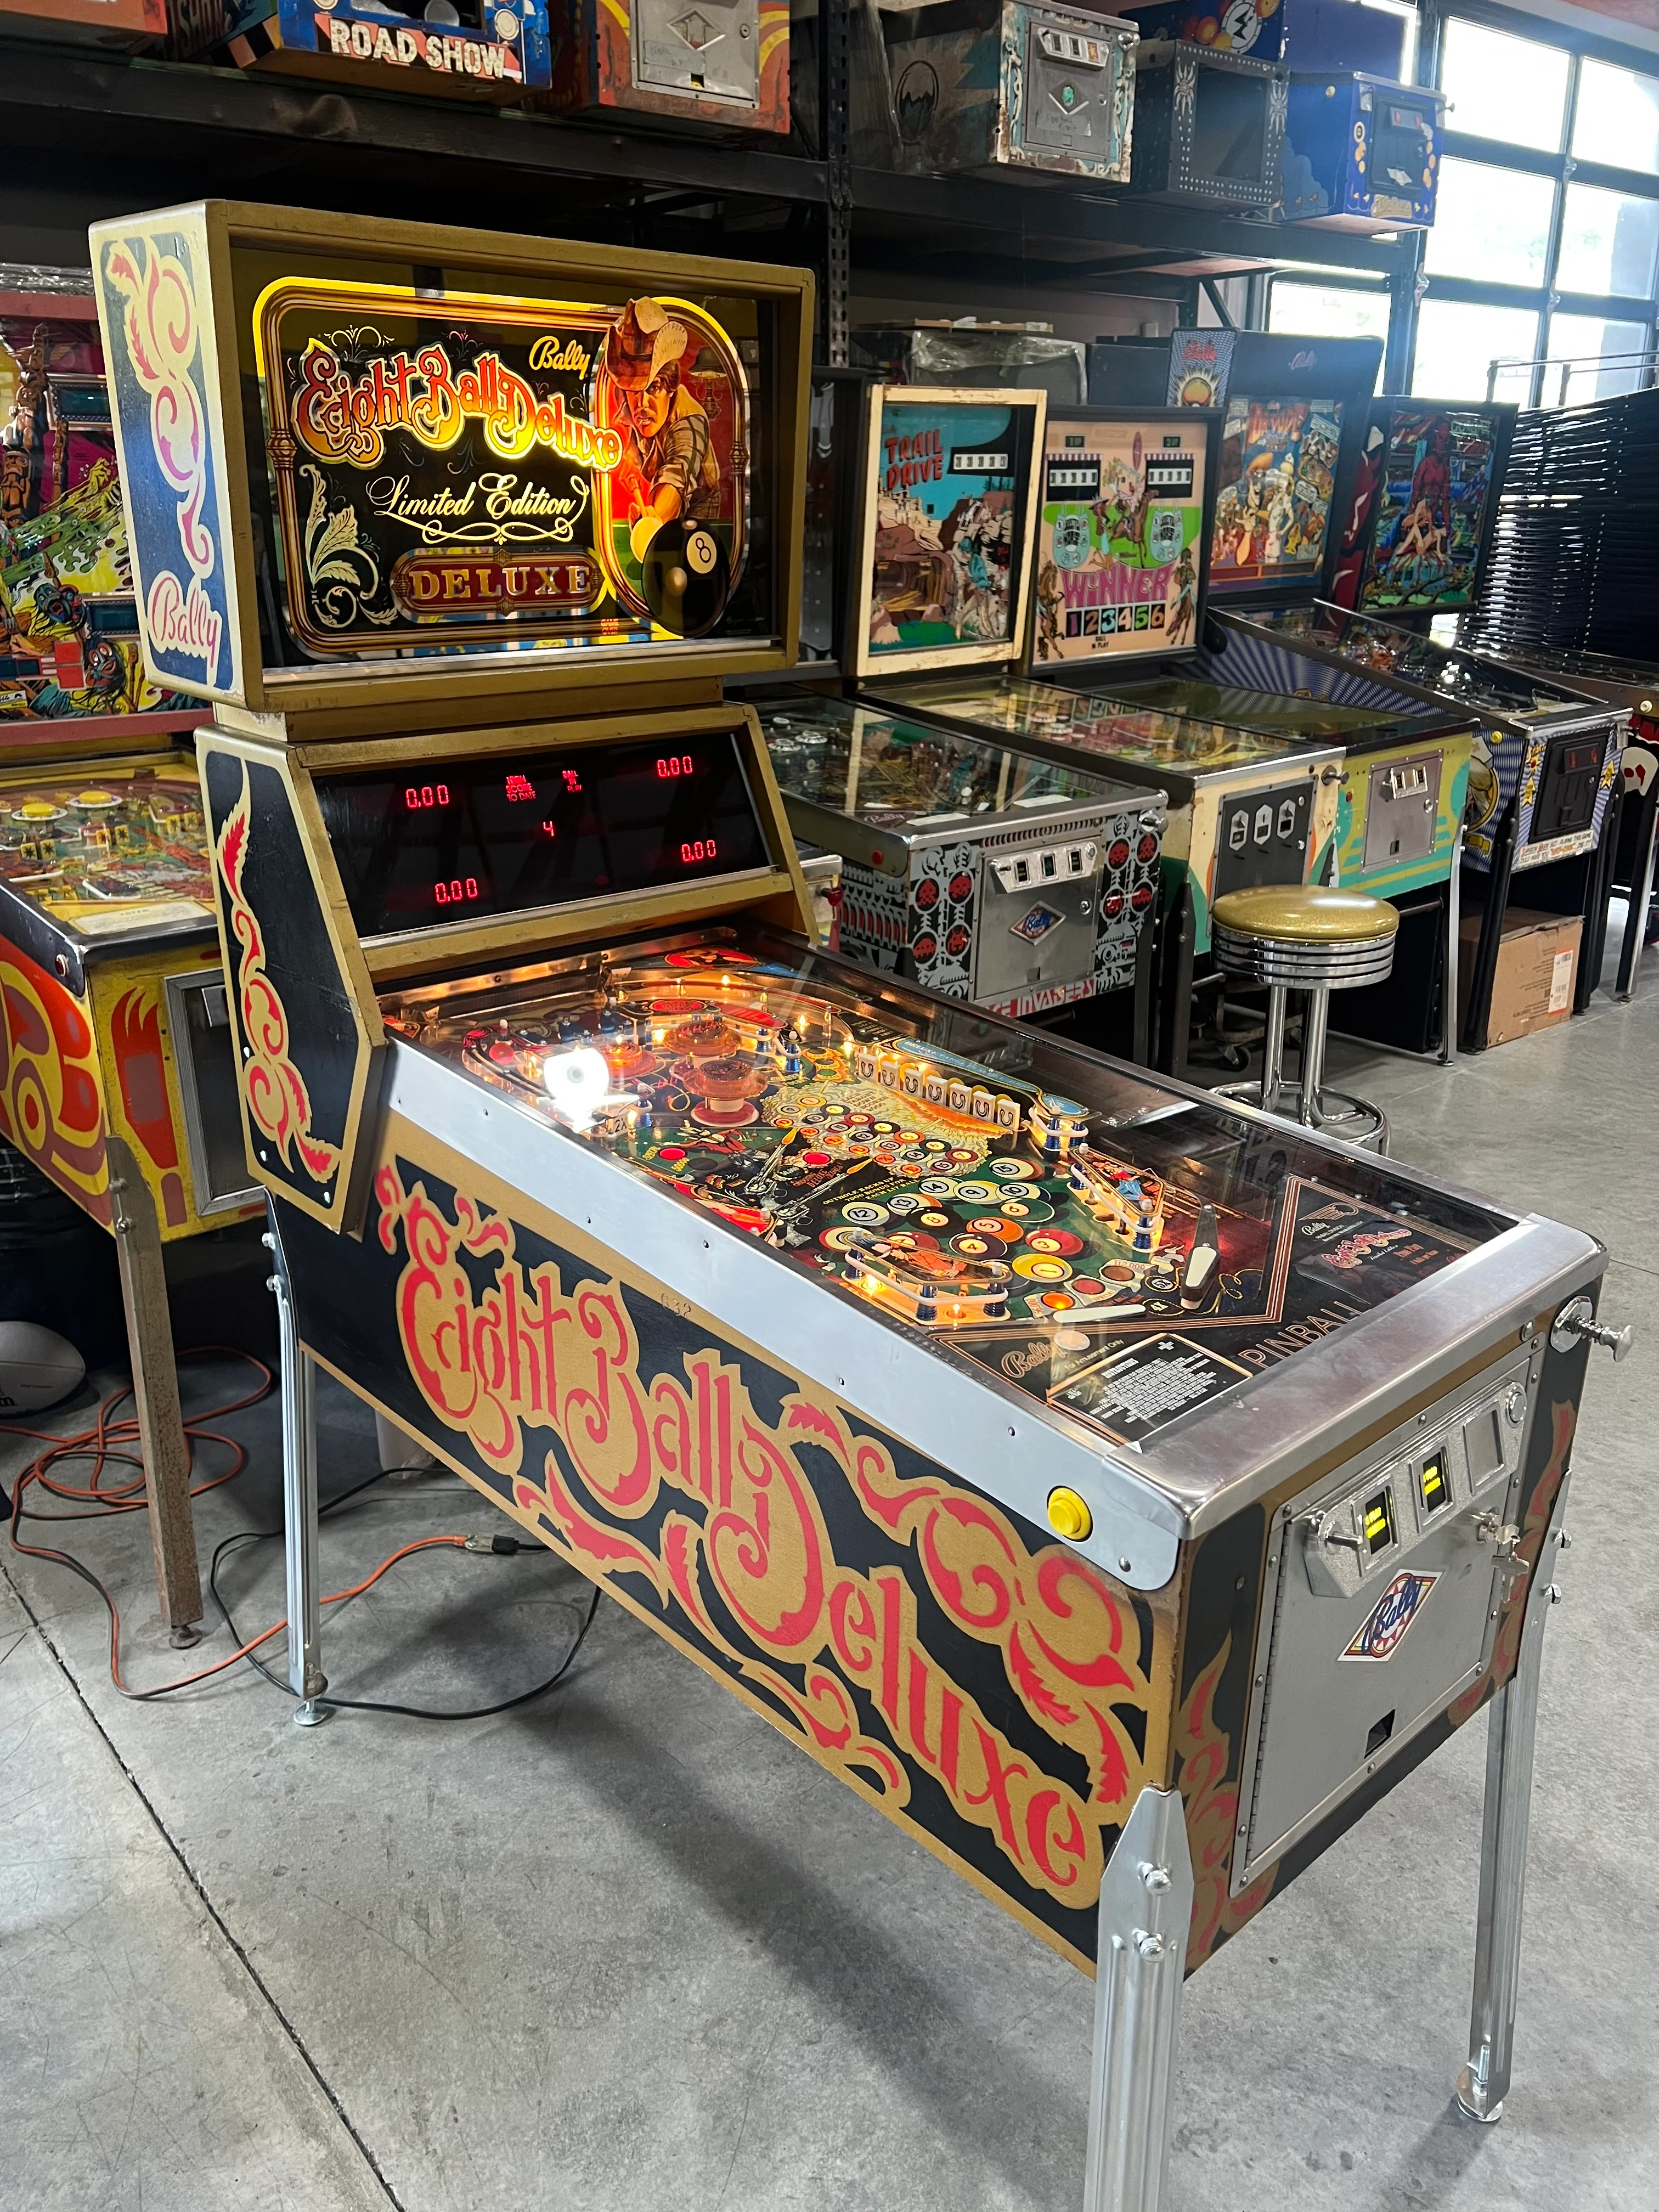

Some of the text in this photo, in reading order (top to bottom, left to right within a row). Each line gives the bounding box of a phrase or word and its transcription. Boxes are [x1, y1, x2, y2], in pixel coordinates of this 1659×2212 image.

[330, 19, 505, 79] ROAD SHOW
[529, 336, 592, 381] Bally
[296, 336, 624, 471] Eight Ball Deluxe
[885, 429, 944, 464] TRAIL
[887, 455, 944, 490] DRIVE
[367, 473, 590, 523] Limited Edition
[695, 537, 712, 562] 8
[410, 566, 592, 601] DELUXE
[151, 575, 218, 669] Bally
[1070, 613, 1078, 635] 1
[1086, 611, 1098, 634] 2
[1101, 610, 1116, 633] 3
[1119, 607, 1131, 630] 4
[1135, 606, 1148, 629] 5
[1152, 605, 1164, 627] 6
[562, 770, 579, 779] BALL
[505, 782, 533, 793] SCORE
[506, 791, 537, 802] TO DATE
[566, 784, 582, 792] PLAY
[543, 820, 555, 837] 4
[864, 813, 905, 823] Bally
[1017, 979, 1096, 1017] INVADERS
[854, 1096, 876, 1107] DOWN
[614, 1114, 627, 1133] 2X
[806, 1169, 828, 1188] DELUXE
[995, 1165, 1013, 1173] 15
[823, 1187, 858, 1205] OUTHOLE
[859, 1180, 885, 1193] RACKS
[844, 1178, 906, 1202] 7000 BONUS FOR
[865, 1178, 920, 1200] EACH LIT BALL
[926, 1183, 943, 1192] 14
[1003, 1187, 1022, 1195] 10
[852, 1210, 870, 1218] 12
[894, 1199, 912, 1208] 13
[927, 1216, 941, 1224] 8
[980, 1222, 994, 1231] 5
[1300, 1221, 1330, 1237] Bally
[1038, 1240, 1049, 1249] 3
[1155, 1279, 1171, 1288] 5X
[1091, 1290, 1116, 1302] SPECIAL
[1150, 1302, 1169, 1312] 4X
[1238, 1300, 1361, 1370] PINBALL
[1001, 1341, 1068, 1378] Bally
[1075, 1345, 1108, 1366] Amusement
[1107, 1339, 1125, 1350] Only
[404, 1190, 1087, 1887] Eight Ball Deluxe
[1361, 1575, 1422, 1655] Bally
